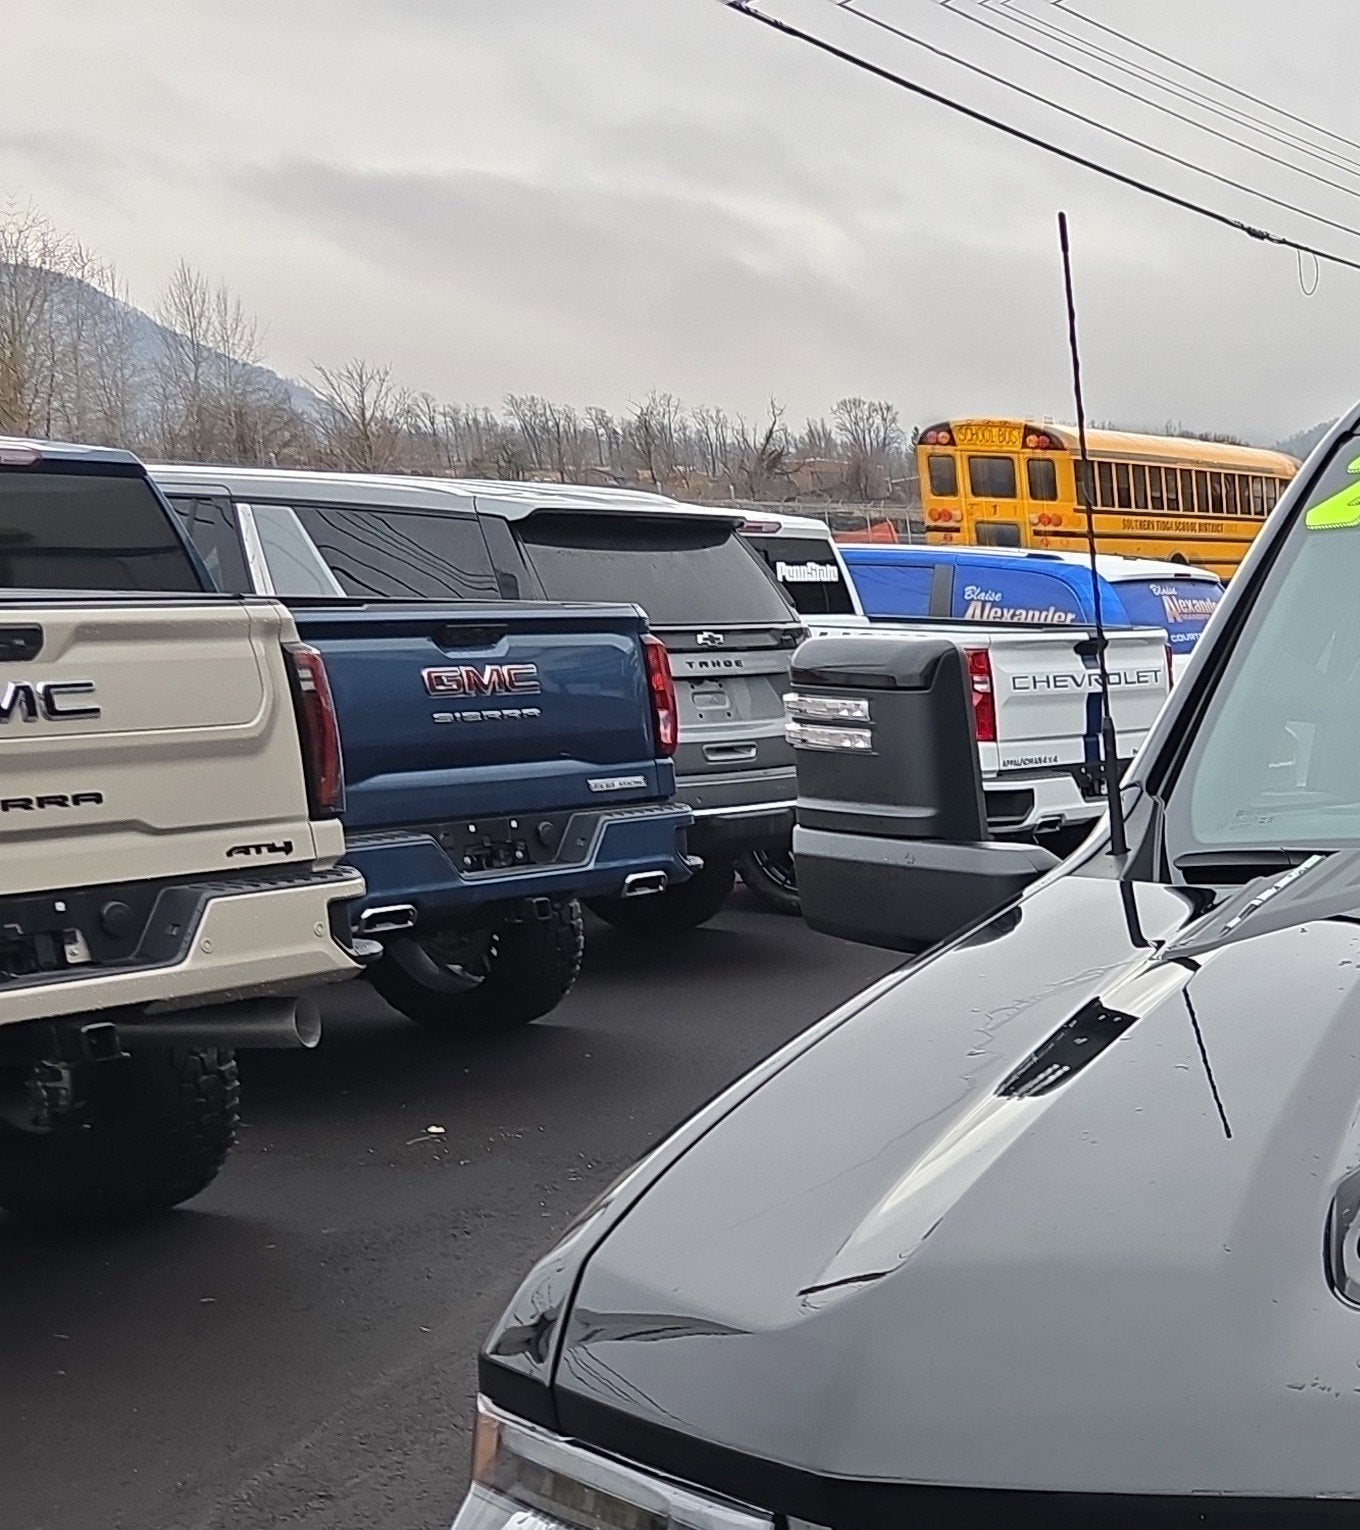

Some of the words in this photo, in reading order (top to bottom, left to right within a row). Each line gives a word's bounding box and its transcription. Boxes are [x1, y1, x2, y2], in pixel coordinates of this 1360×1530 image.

[963, 585, 1002, 601] Blaise
[963, 600, 1077, 624] Alexander
[685, 659, 743, 669] TAHOE
[421, 663, 541, 699] GMC
[1011, 669, 1162, 691] CHEVROLET
[0, 680, 101, 724] MC
[432, 707, 541, 723] SIERRA
[0, 791, 104, 813] RRA
[225, 839, 294, 858] AT4
